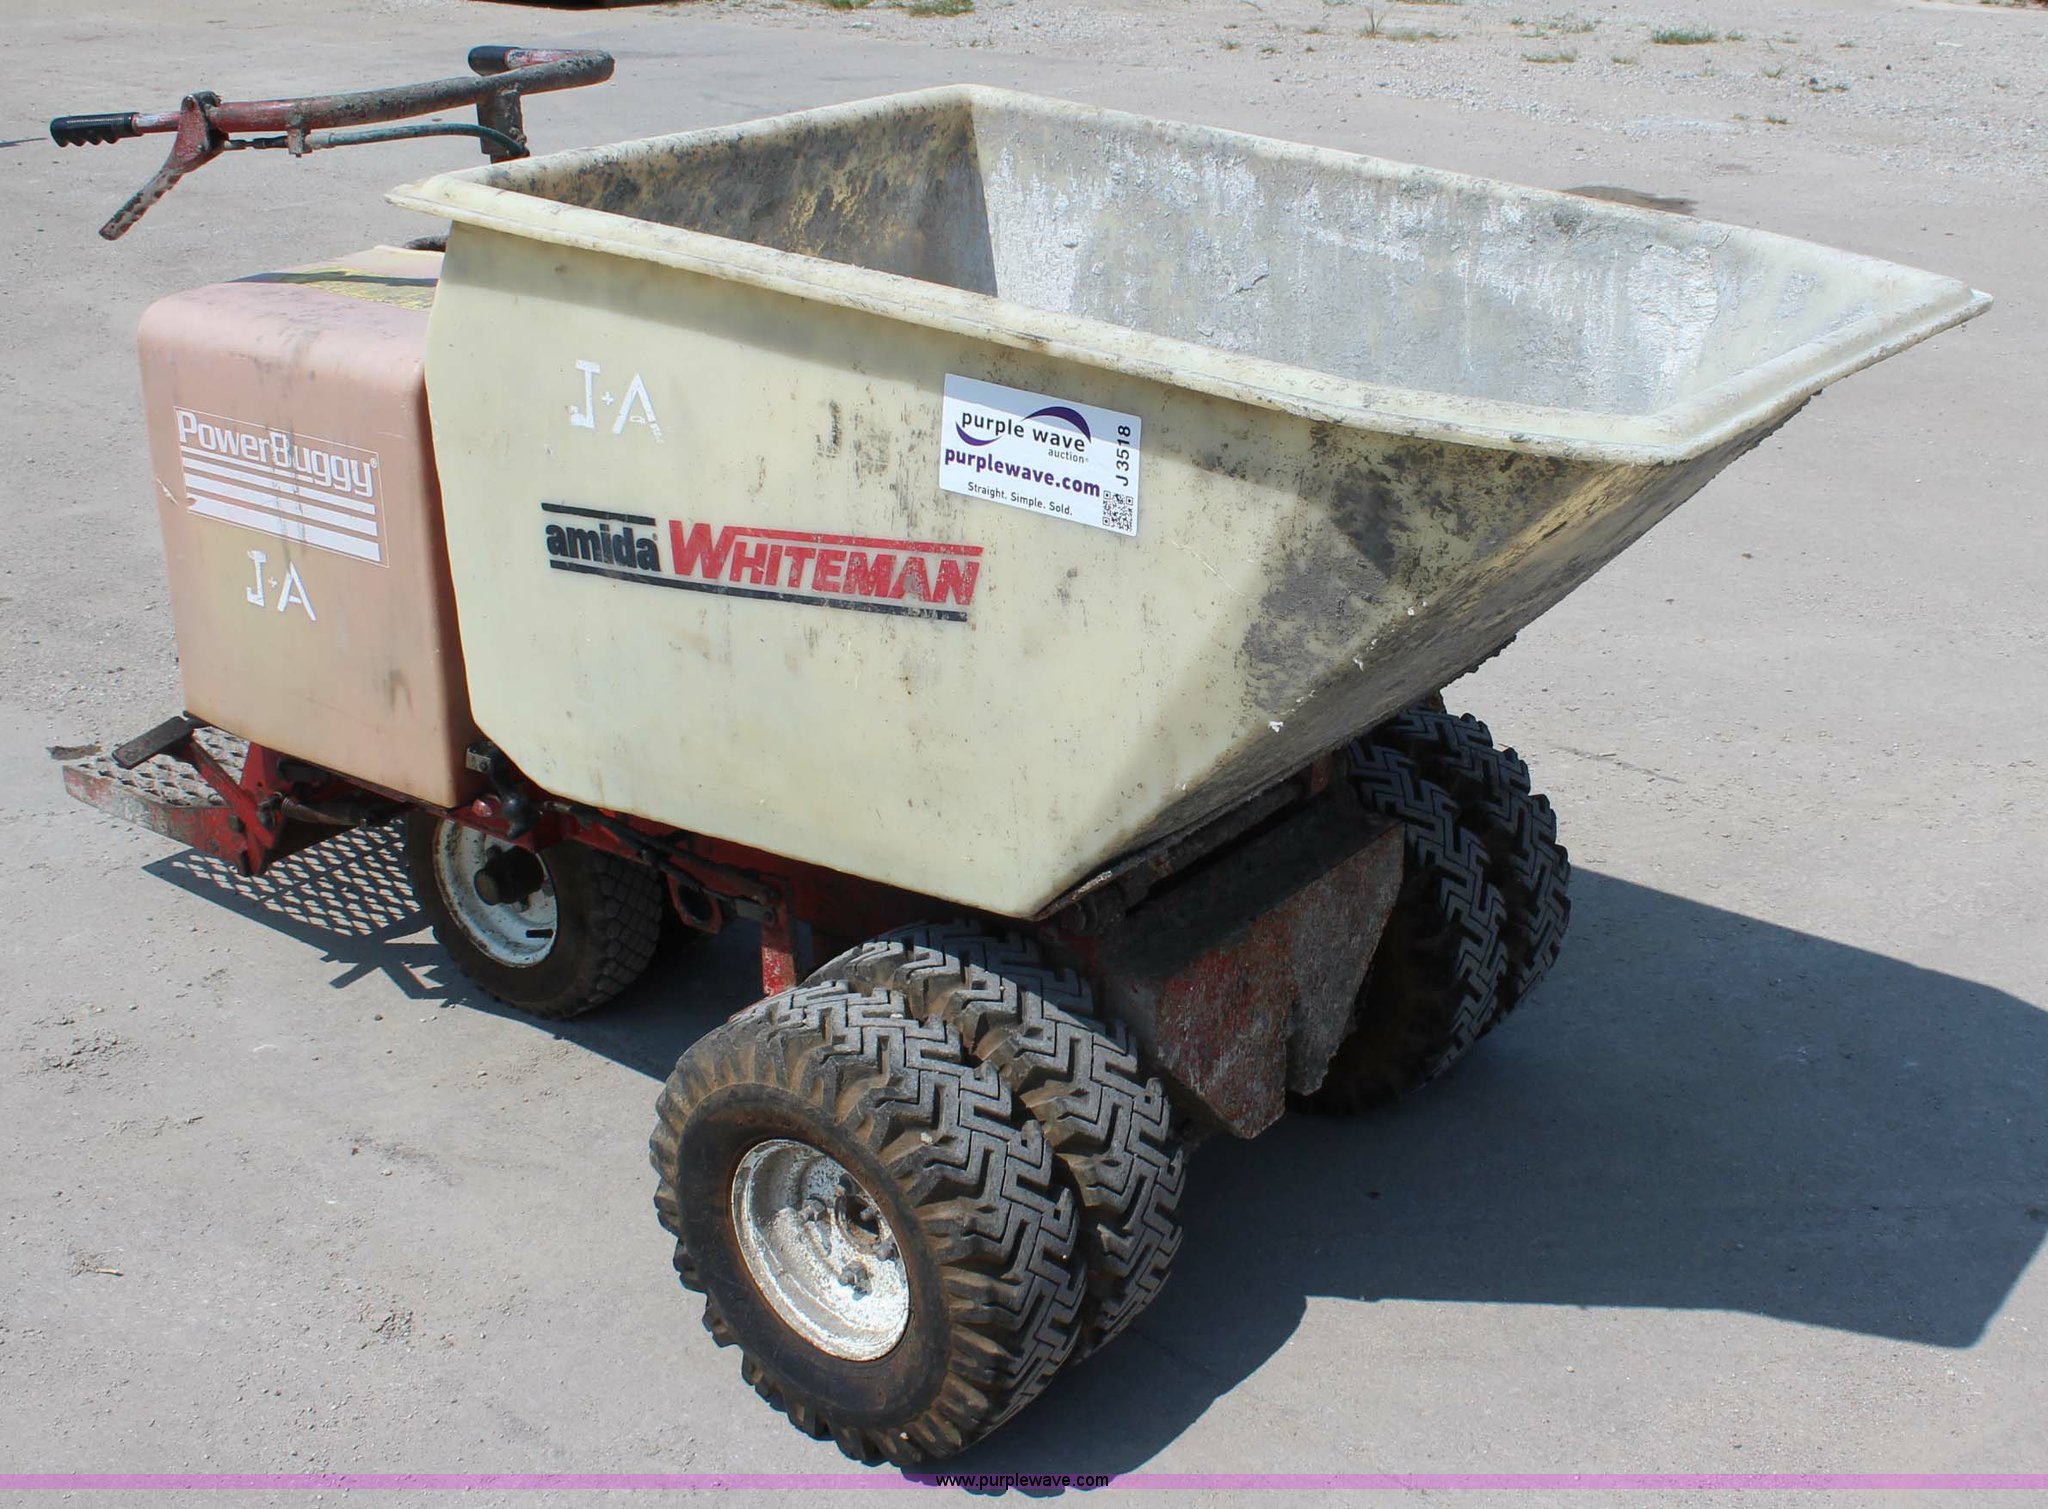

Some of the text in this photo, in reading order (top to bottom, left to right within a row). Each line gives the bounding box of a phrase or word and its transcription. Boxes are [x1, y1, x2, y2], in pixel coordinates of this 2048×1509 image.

[962, 412, 1085, 452] purple wave
[944, 448, 1100, 497] purplewave.com
[1048, 448, 1085, 464] auction
[967, 481, 1073, 516] Straight. Simple. Sold.
[546, 520, 981, 606] amida WHITEMAN
